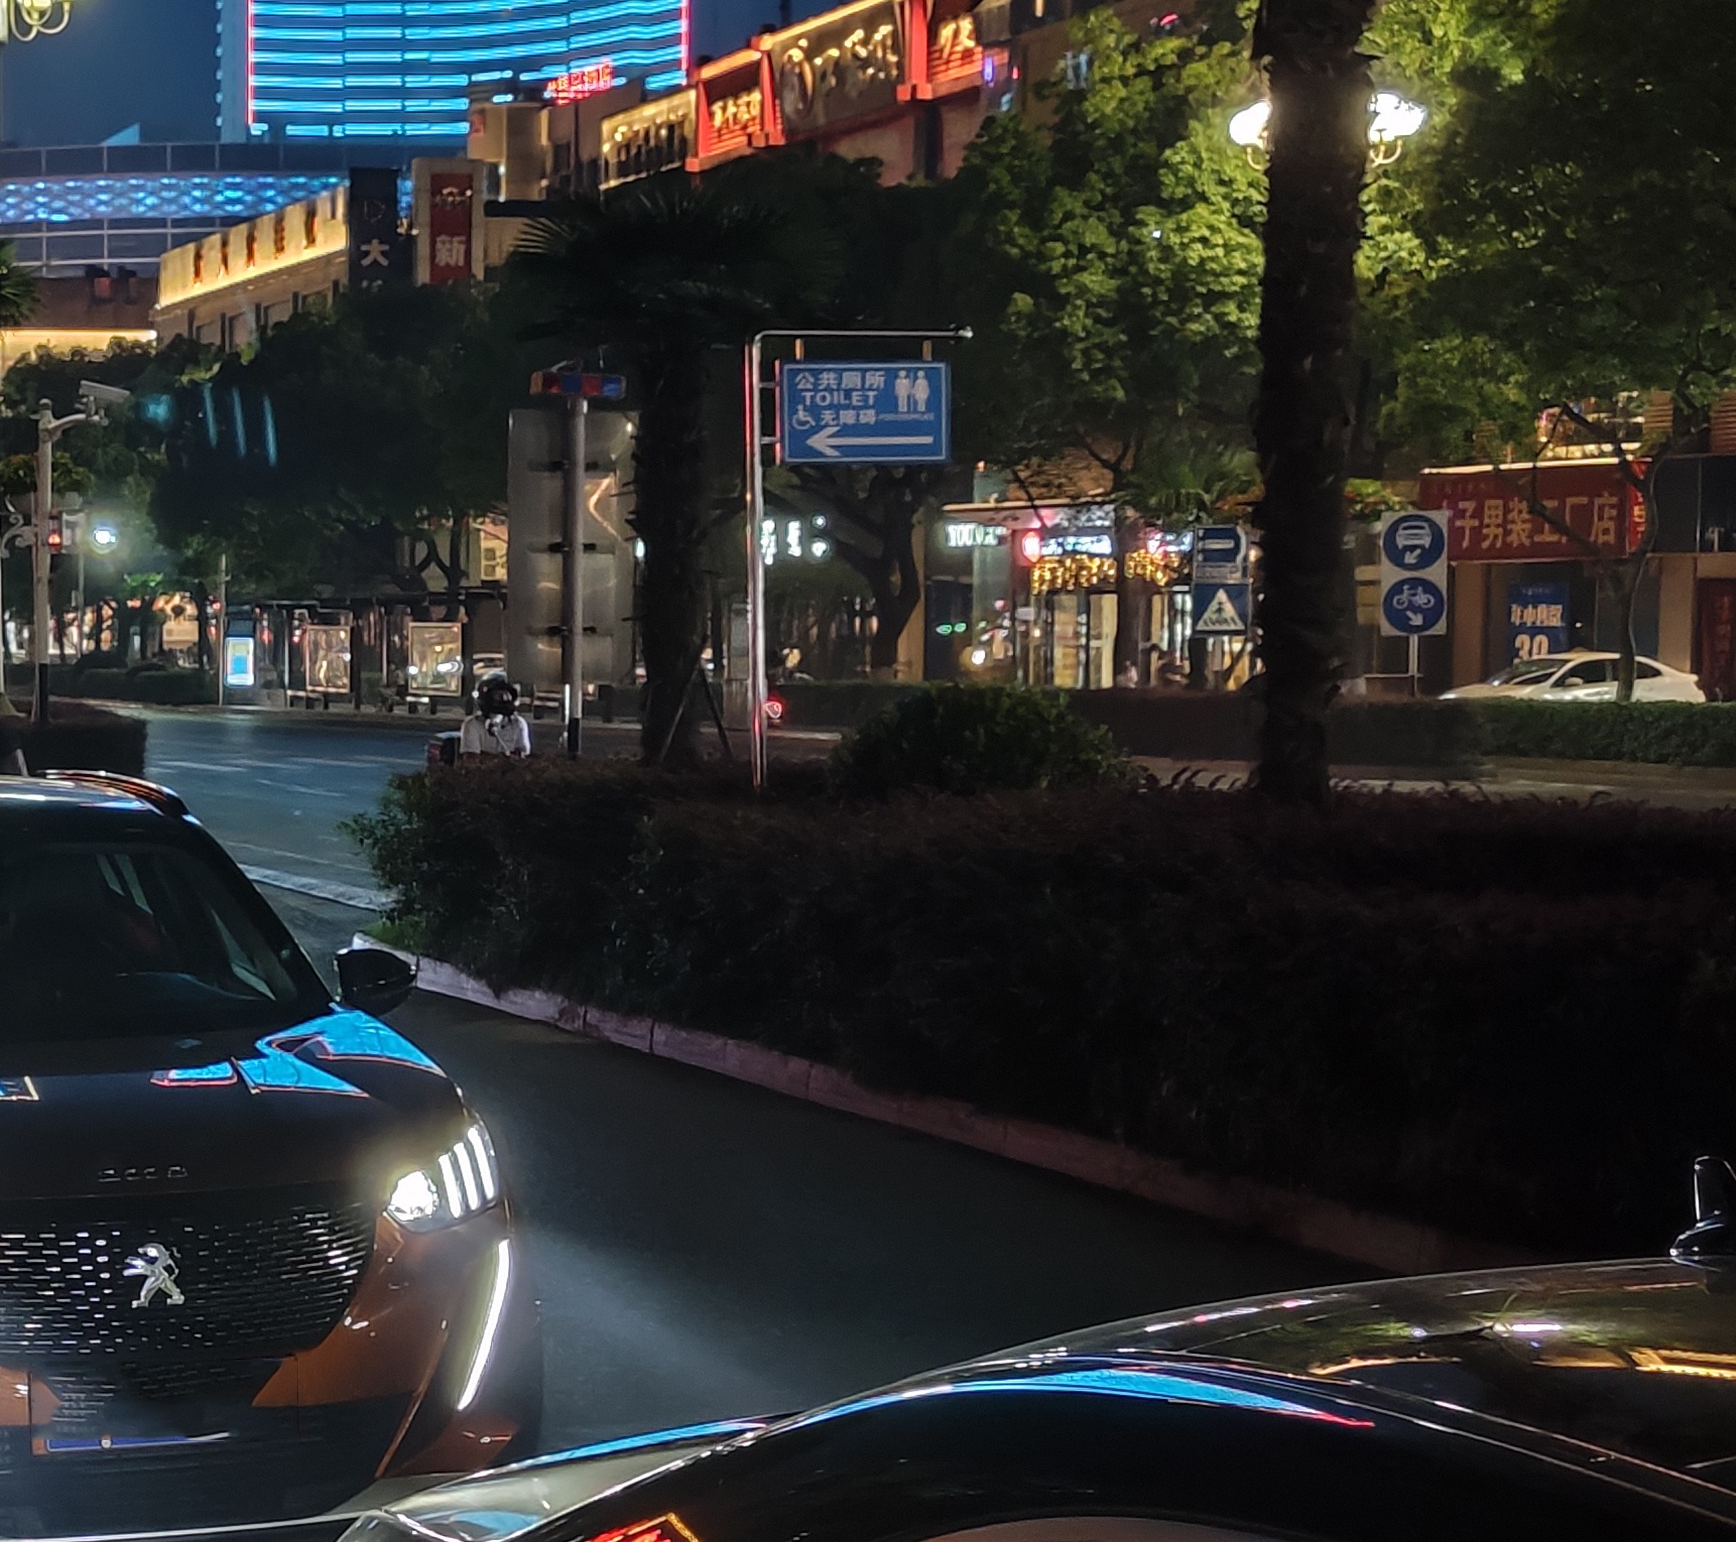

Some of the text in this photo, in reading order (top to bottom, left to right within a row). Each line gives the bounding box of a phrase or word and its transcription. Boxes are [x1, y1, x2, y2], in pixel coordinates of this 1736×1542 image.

[795, 371, 886, 390] 公共厕所
[801, 391, 878, 406] TOILET
[820, 410, 877, 426] 无障碍
[1442, 490, 1619, 549] 子男装工厂店
